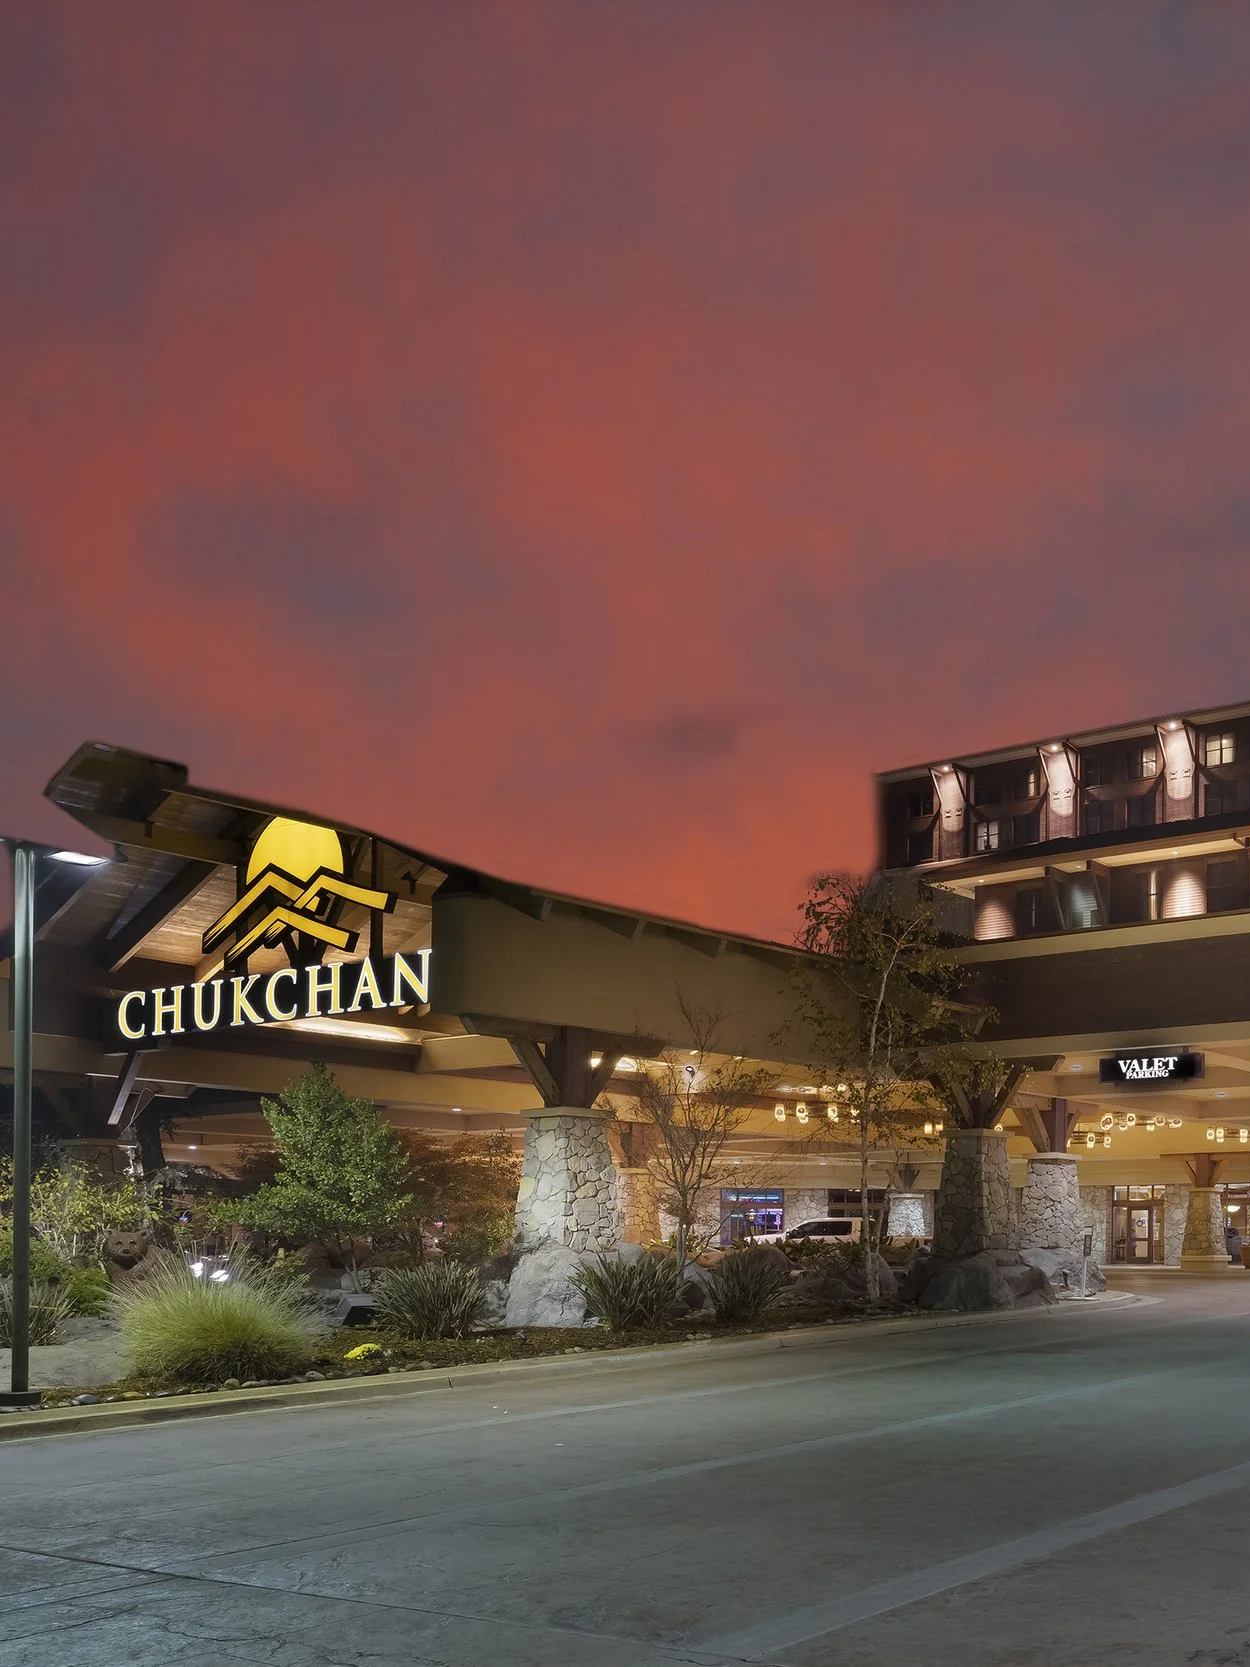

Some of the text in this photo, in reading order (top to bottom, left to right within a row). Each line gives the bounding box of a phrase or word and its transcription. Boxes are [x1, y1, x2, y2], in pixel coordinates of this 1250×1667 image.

[117, 948, 433, 1040] CHUKCHAN
[1117, 1056, 1178, 1073] VALET
[1125, 1069, 1169, 1079] PARKING
